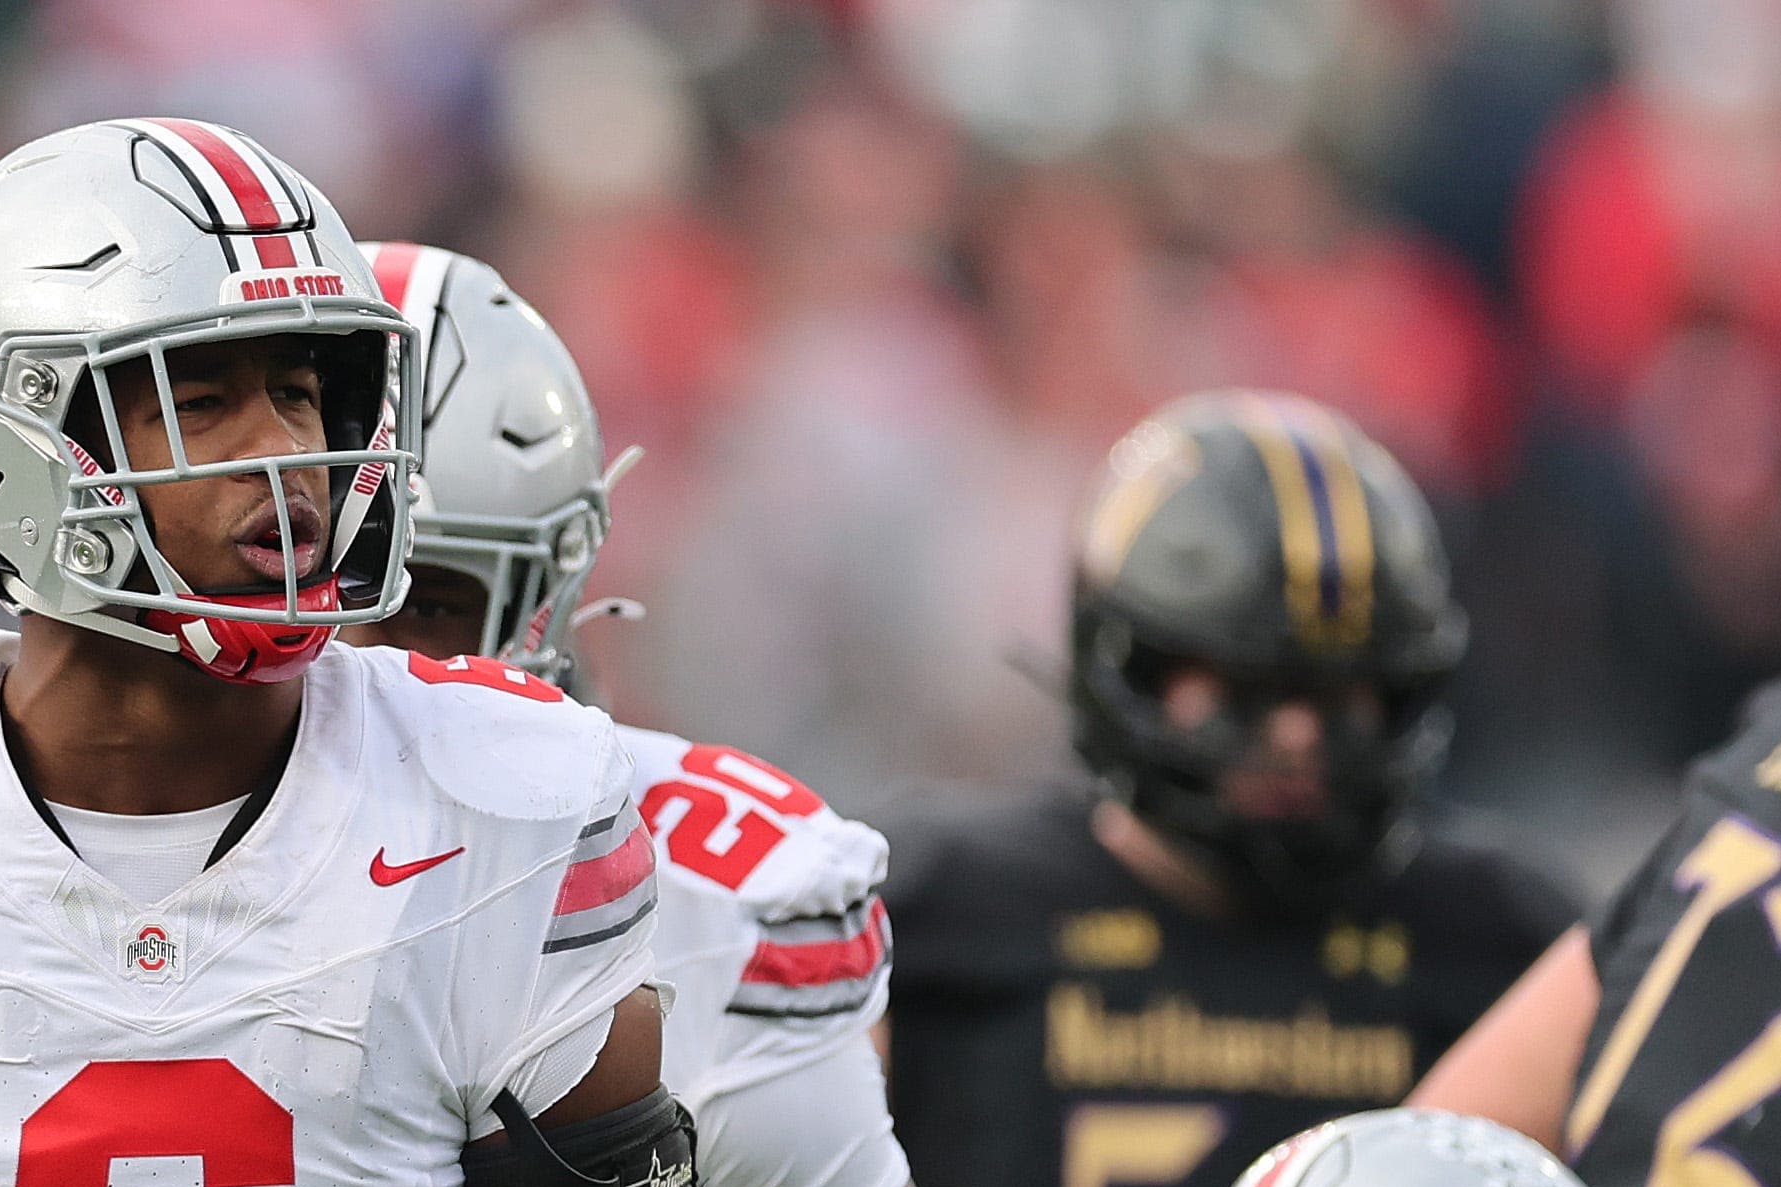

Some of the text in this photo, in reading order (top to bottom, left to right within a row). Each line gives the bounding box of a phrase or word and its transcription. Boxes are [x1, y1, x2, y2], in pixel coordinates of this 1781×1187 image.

[240, 275, 344, 301] OHIO STATE
[638, 743, 829, 893] 20
